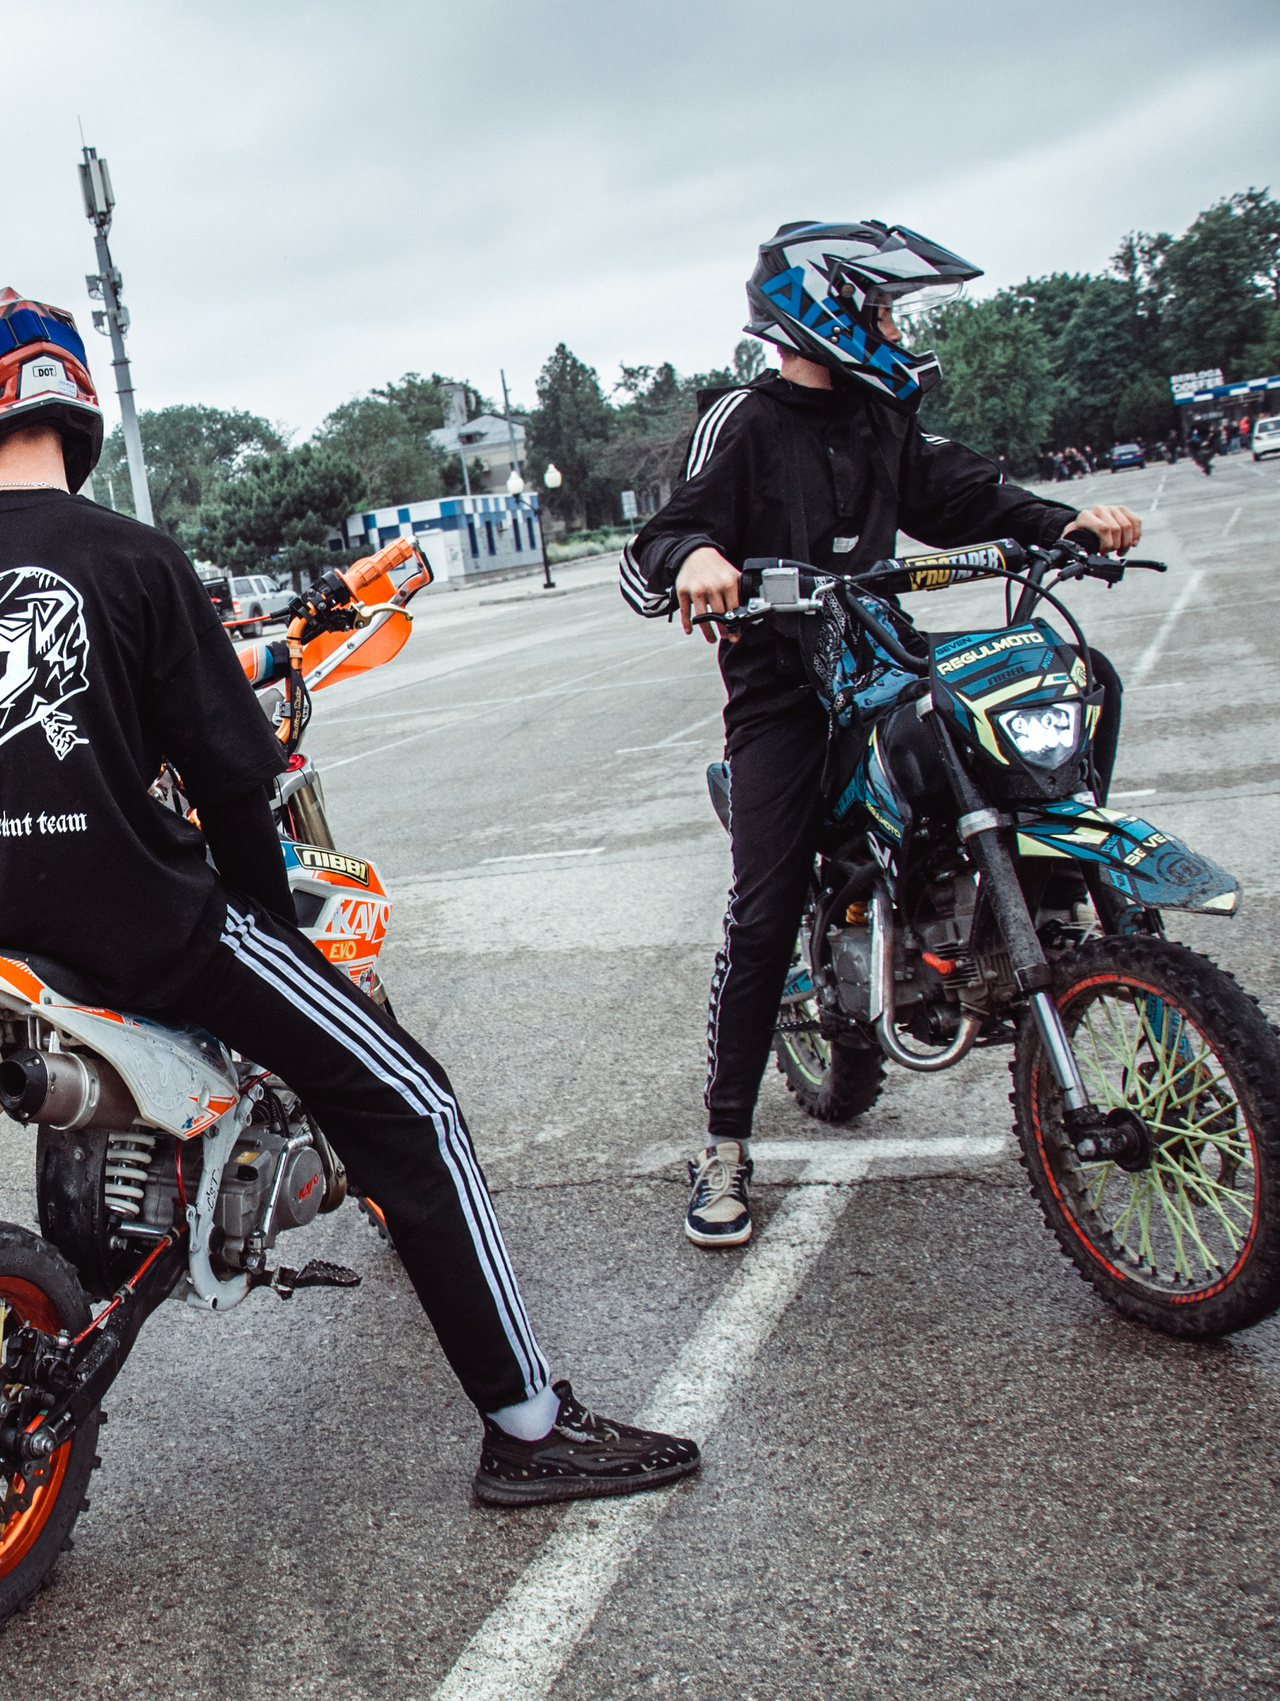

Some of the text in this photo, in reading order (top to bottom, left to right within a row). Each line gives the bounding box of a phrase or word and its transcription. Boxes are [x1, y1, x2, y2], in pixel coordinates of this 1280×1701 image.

[38, 368, 54, 377] DOT
[1171, 376, 1224, 394] COFFEE
[936, 637, 972, 655] SEVEN
[936, 632, 1045, 676] REGULMOTO
[987, 665, 1025, 686] NIBBI
[36, 810, 88, 835] team
[302, 850, 366, 880] NIBBI
[329, 899, 392, 942] KAYO
[329, 941, 357, 960] EVO
